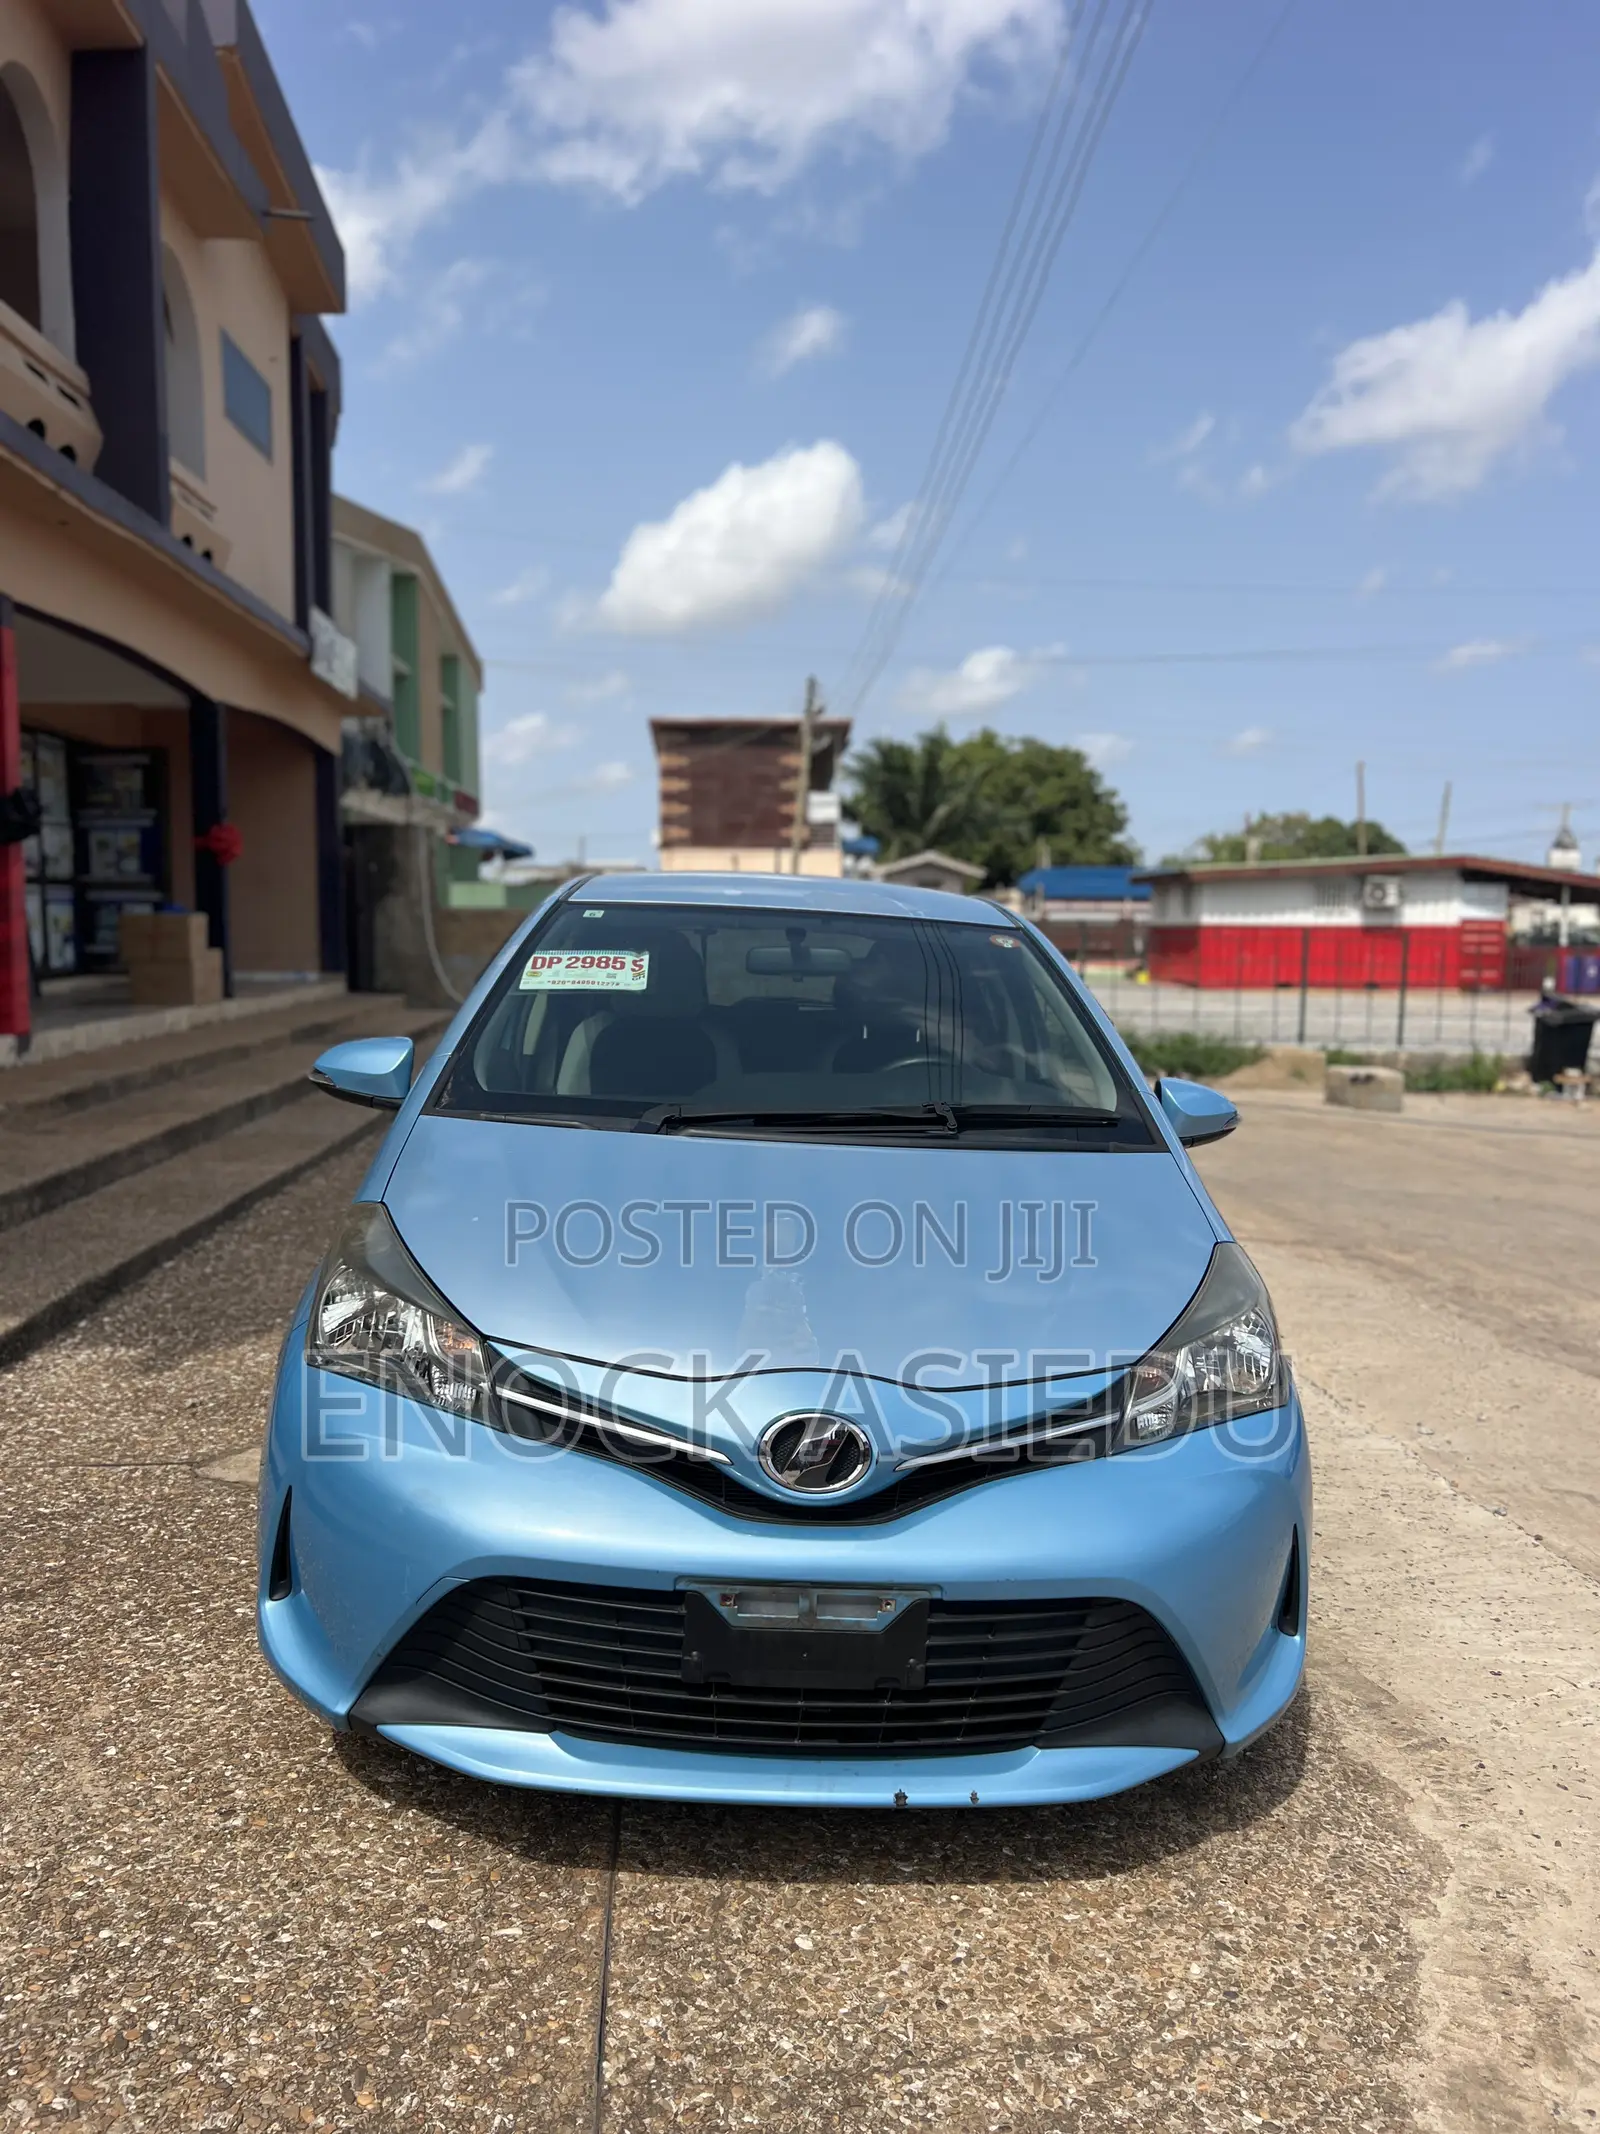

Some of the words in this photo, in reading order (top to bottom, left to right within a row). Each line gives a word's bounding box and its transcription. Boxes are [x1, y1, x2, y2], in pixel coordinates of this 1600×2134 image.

[531, 956, 563, 970] DP
[565, 956, 626, 970] 2985
[631, 958, 645, 972] S
